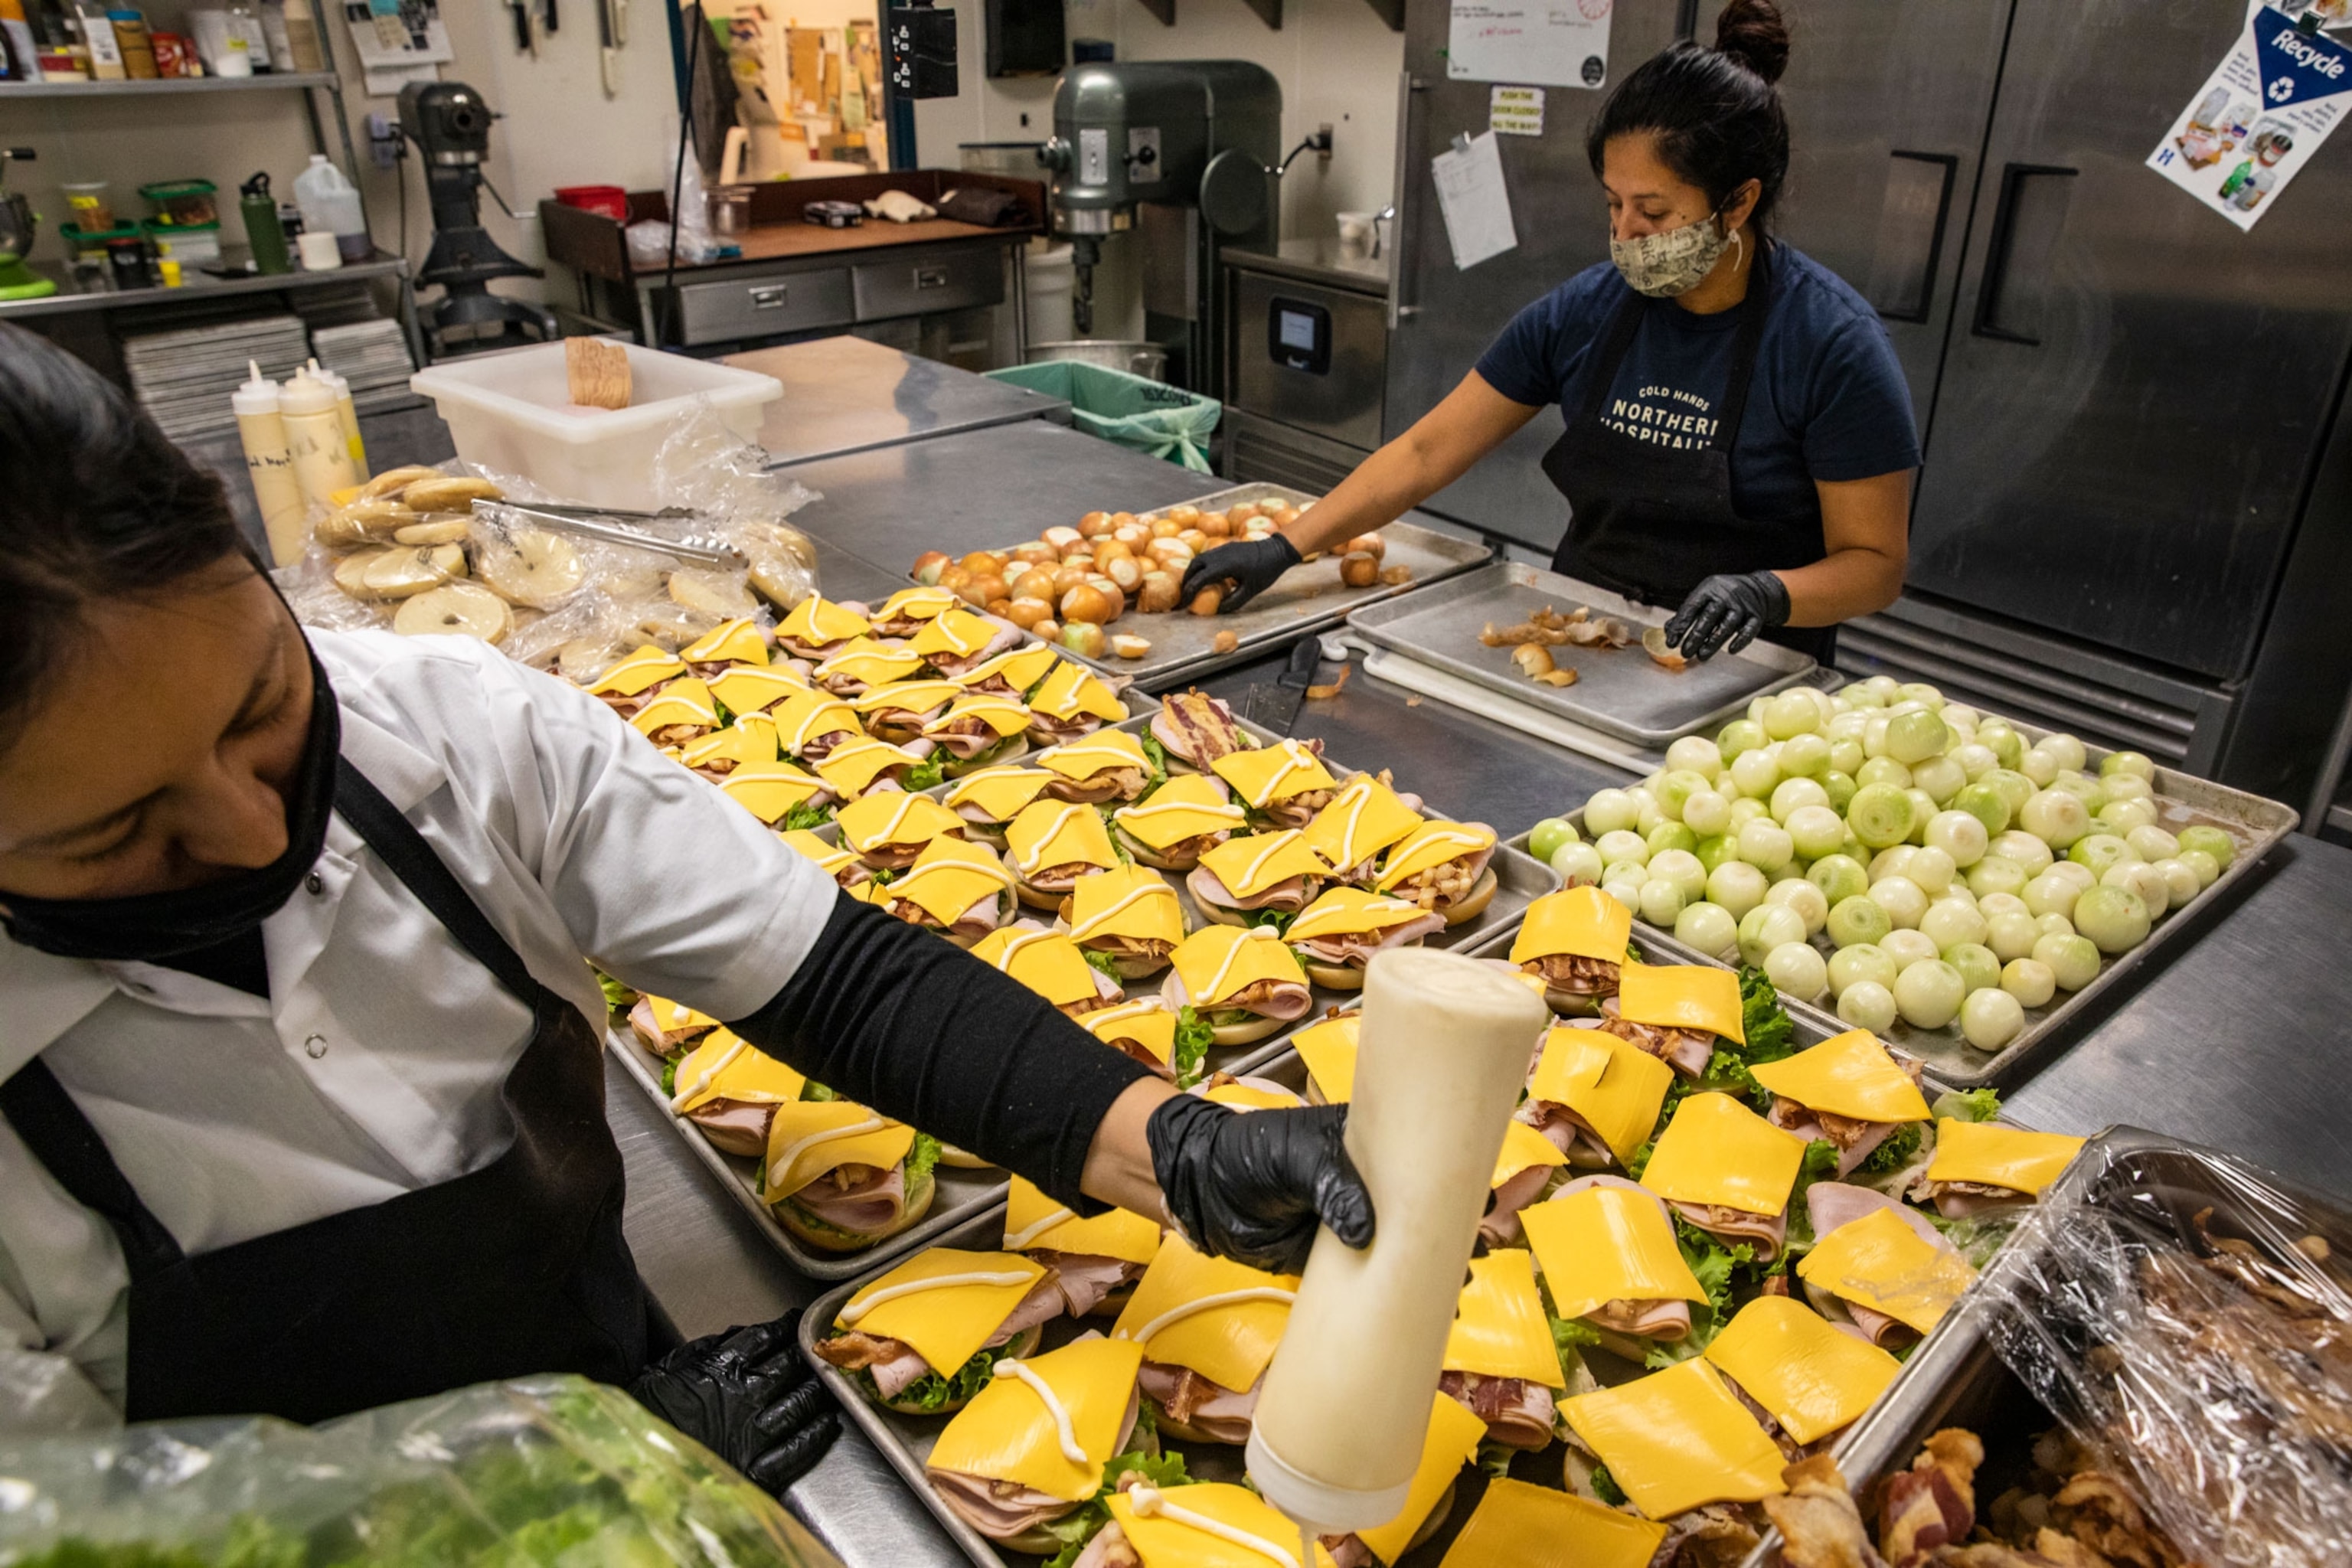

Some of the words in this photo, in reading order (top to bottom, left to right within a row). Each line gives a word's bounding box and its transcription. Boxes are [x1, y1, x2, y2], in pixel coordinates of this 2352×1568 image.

[2271, 28, 2346, 80] Recycle
[1638, 385, 1670, 398] COLD
[1672, 390, 1710, 412] HANDS
